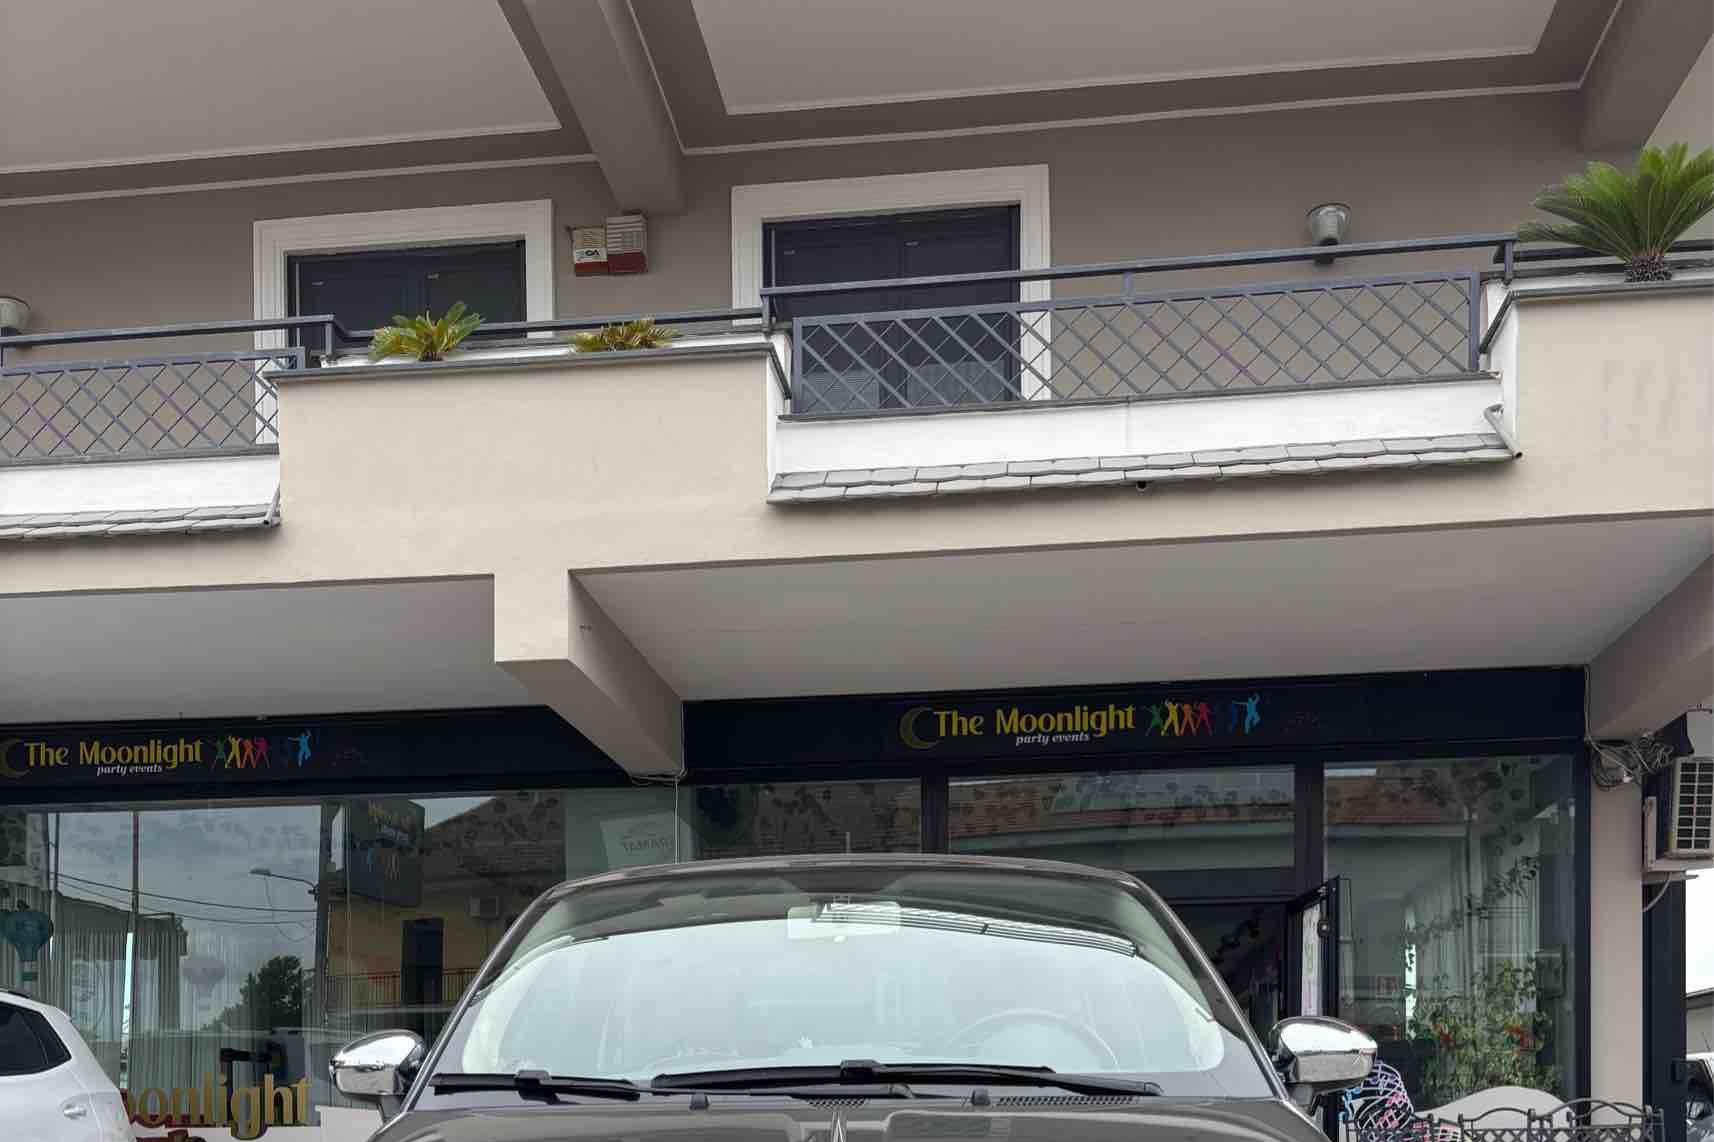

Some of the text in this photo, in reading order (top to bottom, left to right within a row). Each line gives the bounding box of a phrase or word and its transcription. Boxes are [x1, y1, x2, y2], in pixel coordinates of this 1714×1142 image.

[934, 704, 1136, 738] The Moonlight
[1016, 731, 1090, 747] party events
[24, 738, 203, 769] The Moonlight
[96, 763, 163, 777] party events
